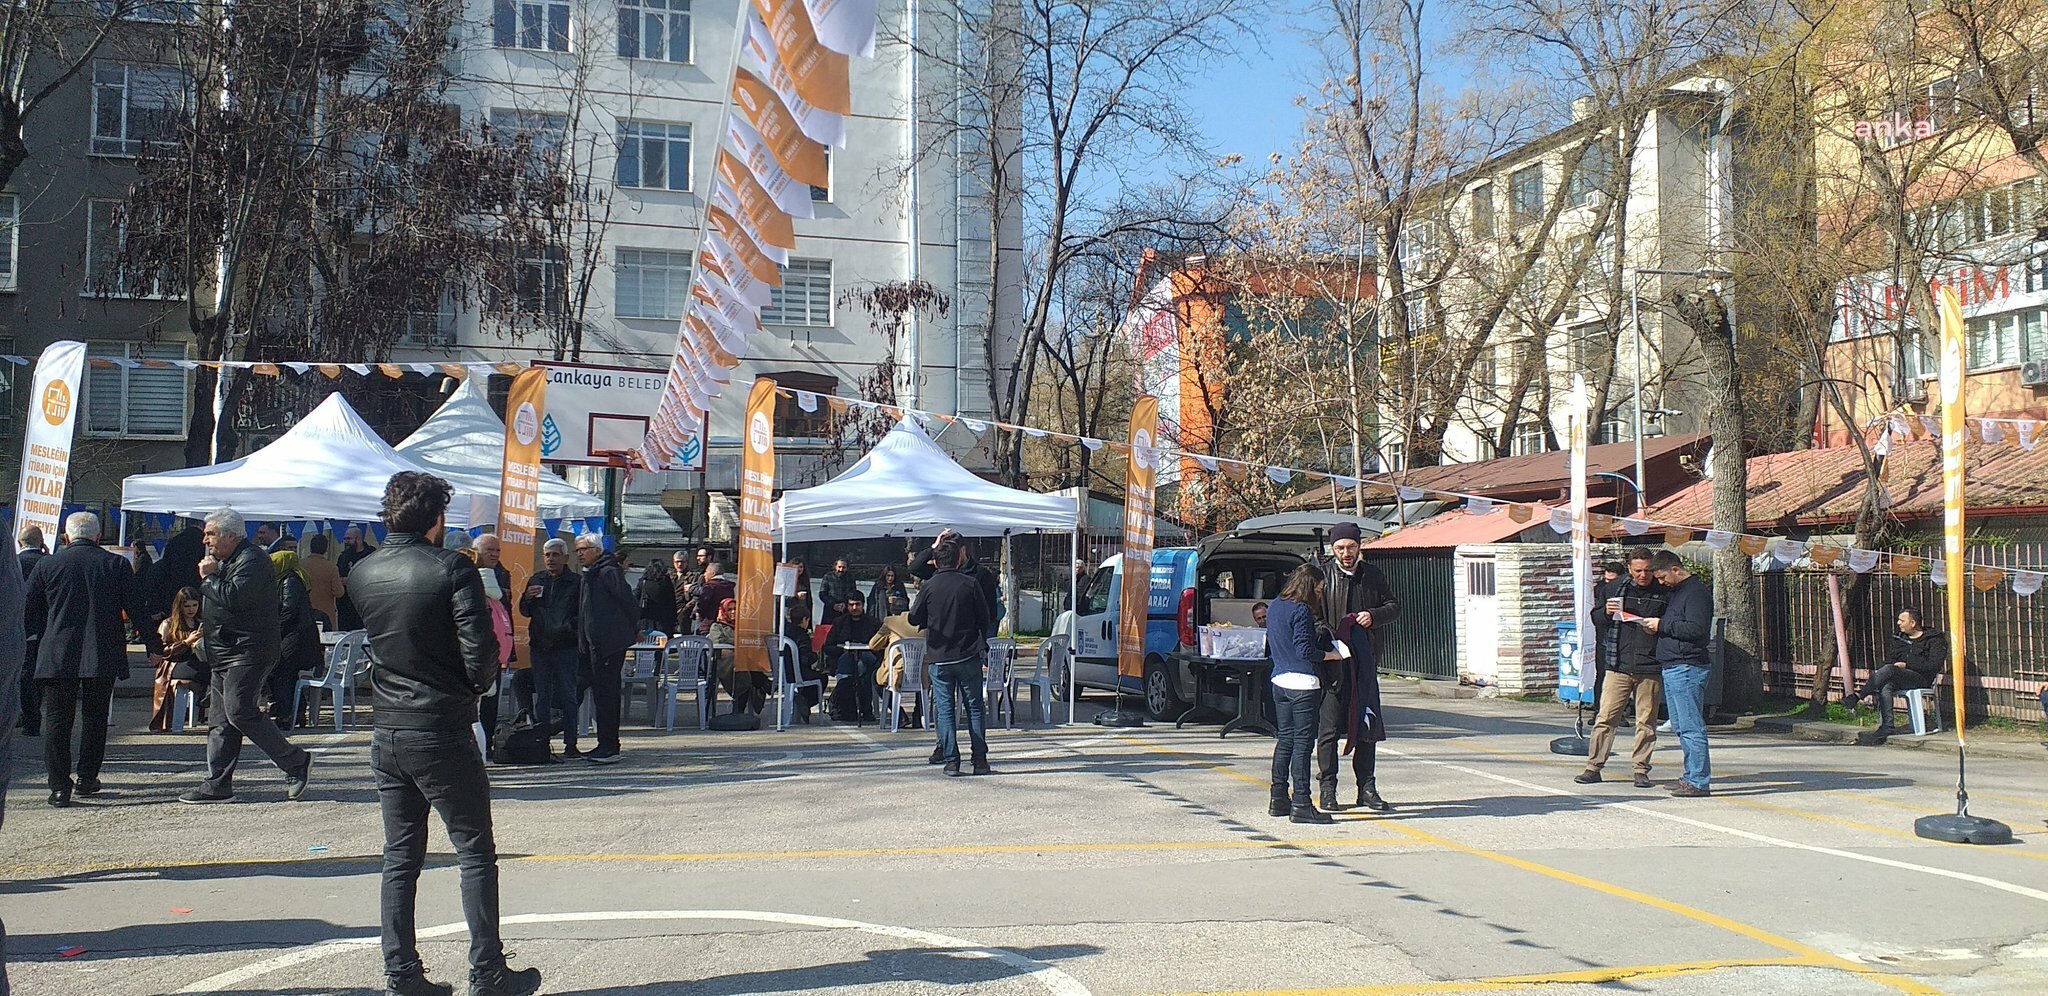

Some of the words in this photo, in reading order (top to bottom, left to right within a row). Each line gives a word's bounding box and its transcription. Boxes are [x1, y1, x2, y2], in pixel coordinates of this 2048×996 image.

[30, 443, 68, 463] MESLEĞİN
[27, 457, 52, 475] İTİBARI
[52, 462, 66, 478] İÇİN
[25, 475, 63, 498] OYLAR
[23, 498, 60, 517] TURUNCU
[504, 490, 535, 512] OYLAR
